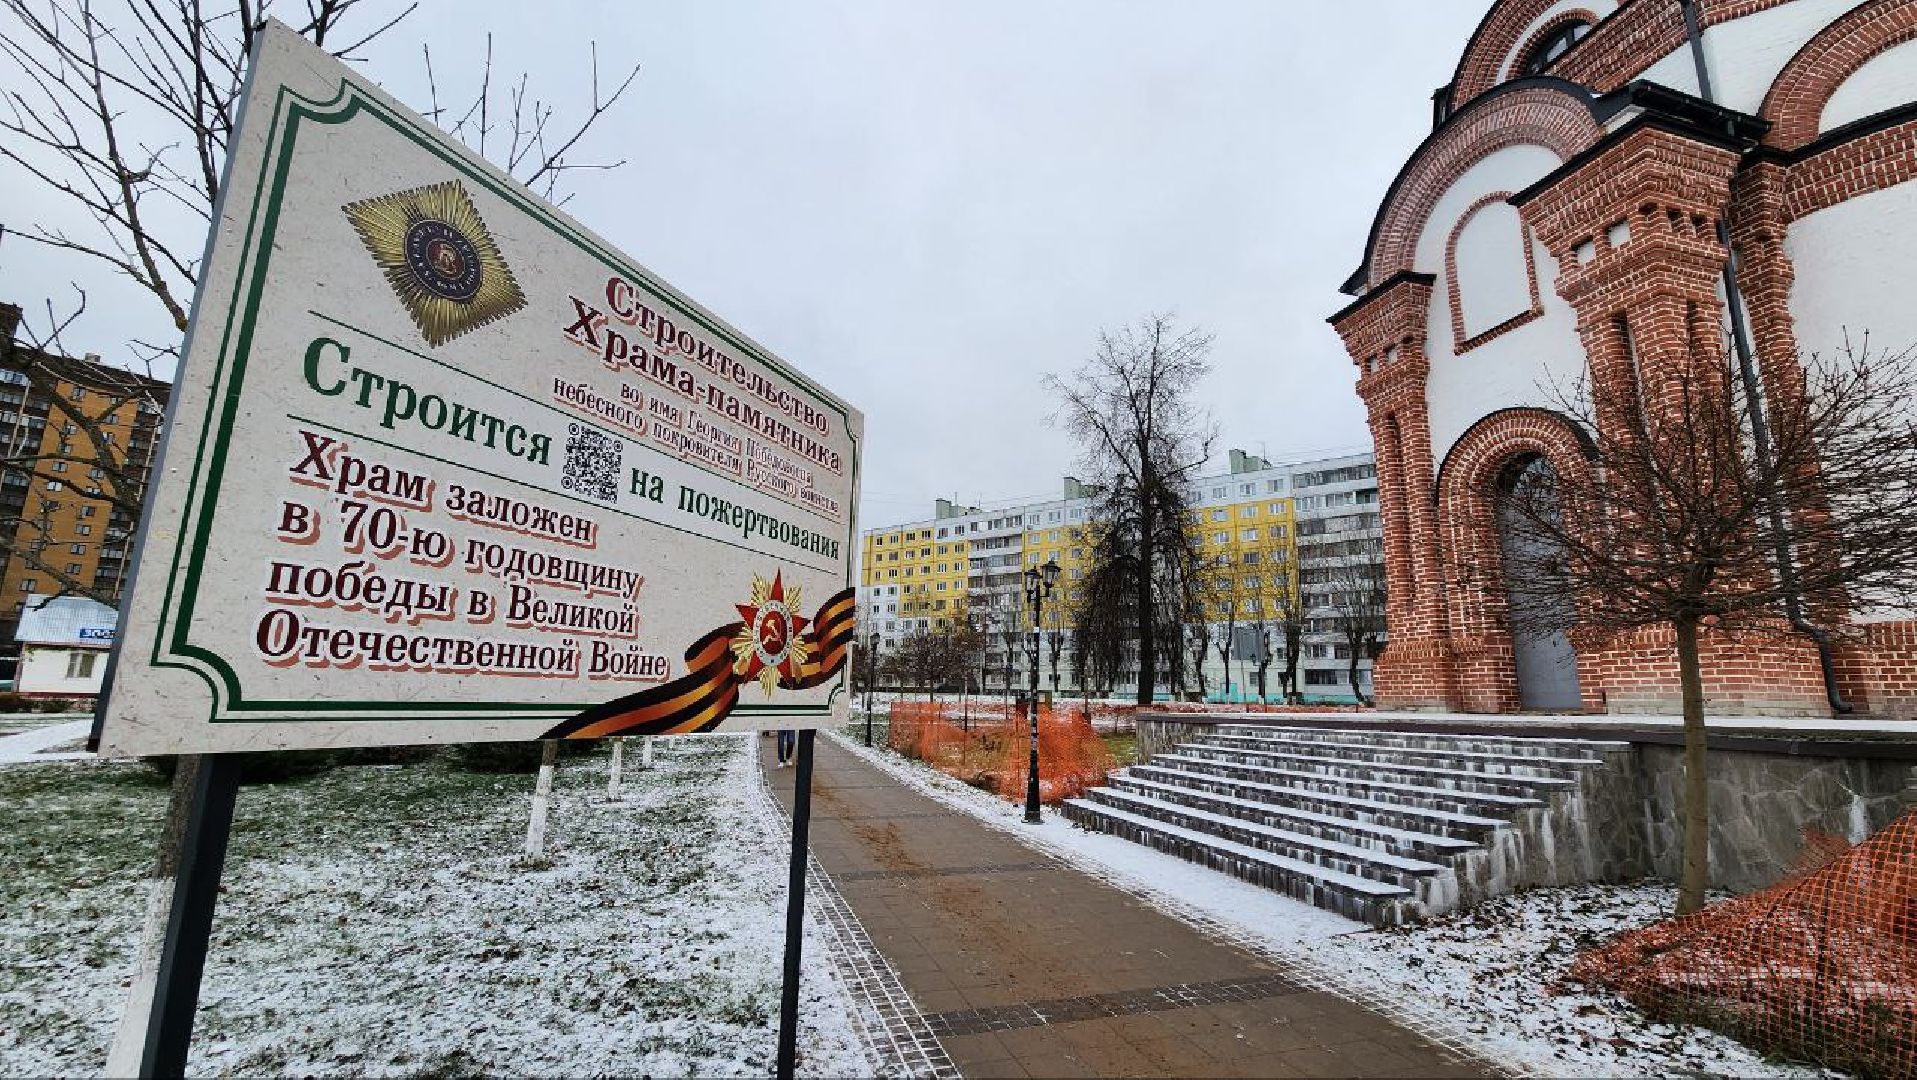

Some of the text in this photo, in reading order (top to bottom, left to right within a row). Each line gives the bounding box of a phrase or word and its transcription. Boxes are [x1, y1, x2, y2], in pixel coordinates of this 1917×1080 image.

[563, 295, 841, 472] Храма-памятника
[606, 277, 828, 433] Строительство
[304, 338, 839, 560] Строится на пожертвования
[554, 378, 645, 431] небесного
[653, 423, 740, 473] покровителя
[621, 383, 641, 405] во
[649, 397, 680, 424] имя
[688, 410, 740, 450] Георгия
[289, 429, 593, 542] Храм заложен
[265, 561, 634, 633] победы в Великой
[278, 501, 641, 599] в 70-ю годовщину
[256, 609, 668, 676] Отечественной Войне
